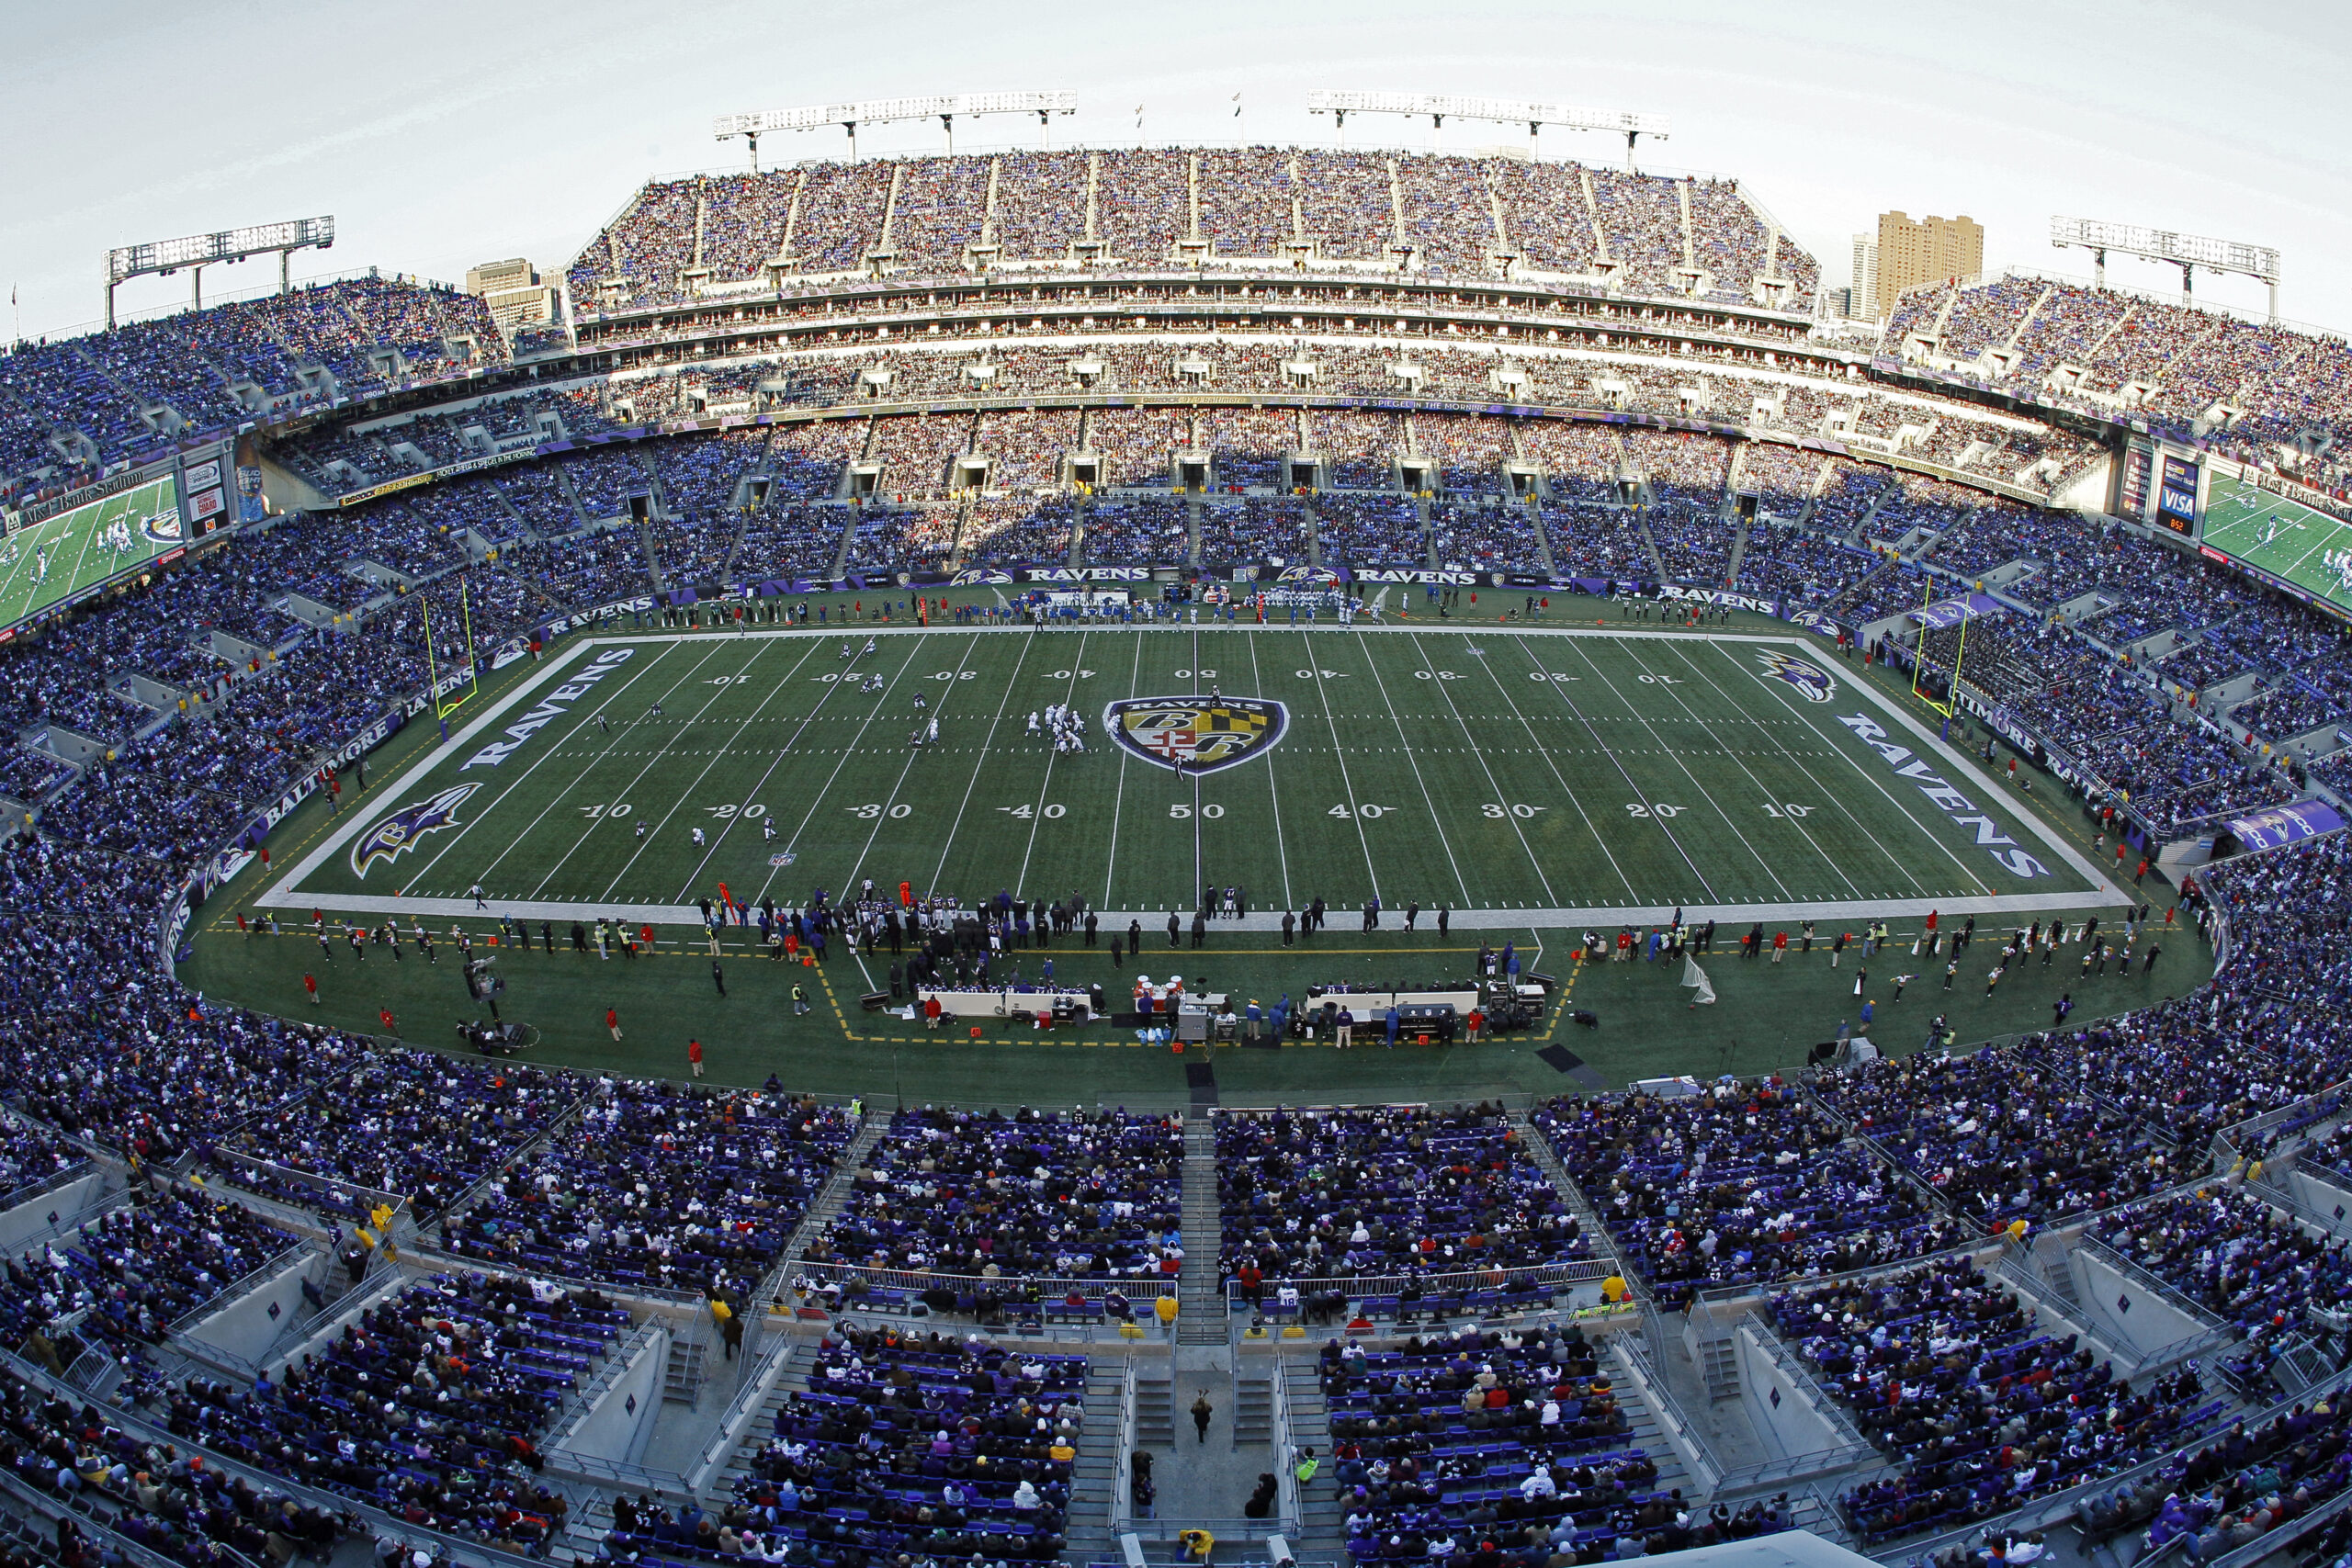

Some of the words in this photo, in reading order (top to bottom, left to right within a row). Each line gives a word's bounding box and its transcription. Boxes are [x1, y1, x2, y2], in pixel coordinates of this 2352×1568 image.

[986, 400, 1023, 408] SPIEGEL
[1326, 398, 1359, 406] AMELIA
[1372, 400, 1409, 408] SPIEGEL
[1444, 402, 1487, 412] MORNING
[2135, 457, 2148, 468] Win
[395, 474, 431, 490] baltimore
[2125, 480, 2136, 491] for
[59, 491, 93, 511] Bank
[95, 471, 145, 497] Stadium
[2291, 484, 2326, 512] Bank
[198, 499, 217, 514] GUARD
[2165, 489, 2194, 516] VISA
[2170, 518, 2184, 531] 8:52
[167, 550, 185, 561] TOYOTA
[2208, 551, 2224, 563] TOYOTA
[1026, 567, 1150, 582] RAVENS
[1353, 569, 1476, 586] RAVENS
[1657, 584, 1775, 615] RAVENS
[548, 597, 653, 636] RAVENS
[458, 648, 637, 773] RAVENS
[1836, 711, 2053, 879] RAVENS
[584, 804, 633, 818] 10
[711, 804, 766, 818] 20
[856, 804, 912, 818] 30
[1011, 803, 1067, 818] 40
[1169, 803, 1225, 818] 50
[1328, 803, 1384, 818] 40
[1480, 803, 1535, 818] 30
[1624, 803, 1678, 818] 20
[1761, 802, 1808, 818] 10
[2278, 807, 2315, 836] GEICO
[2231, 819, 2269, 849] GEICO
[1174, 1043, 1182, 1053] 50
[635, 1514, 651, 1528] 92
